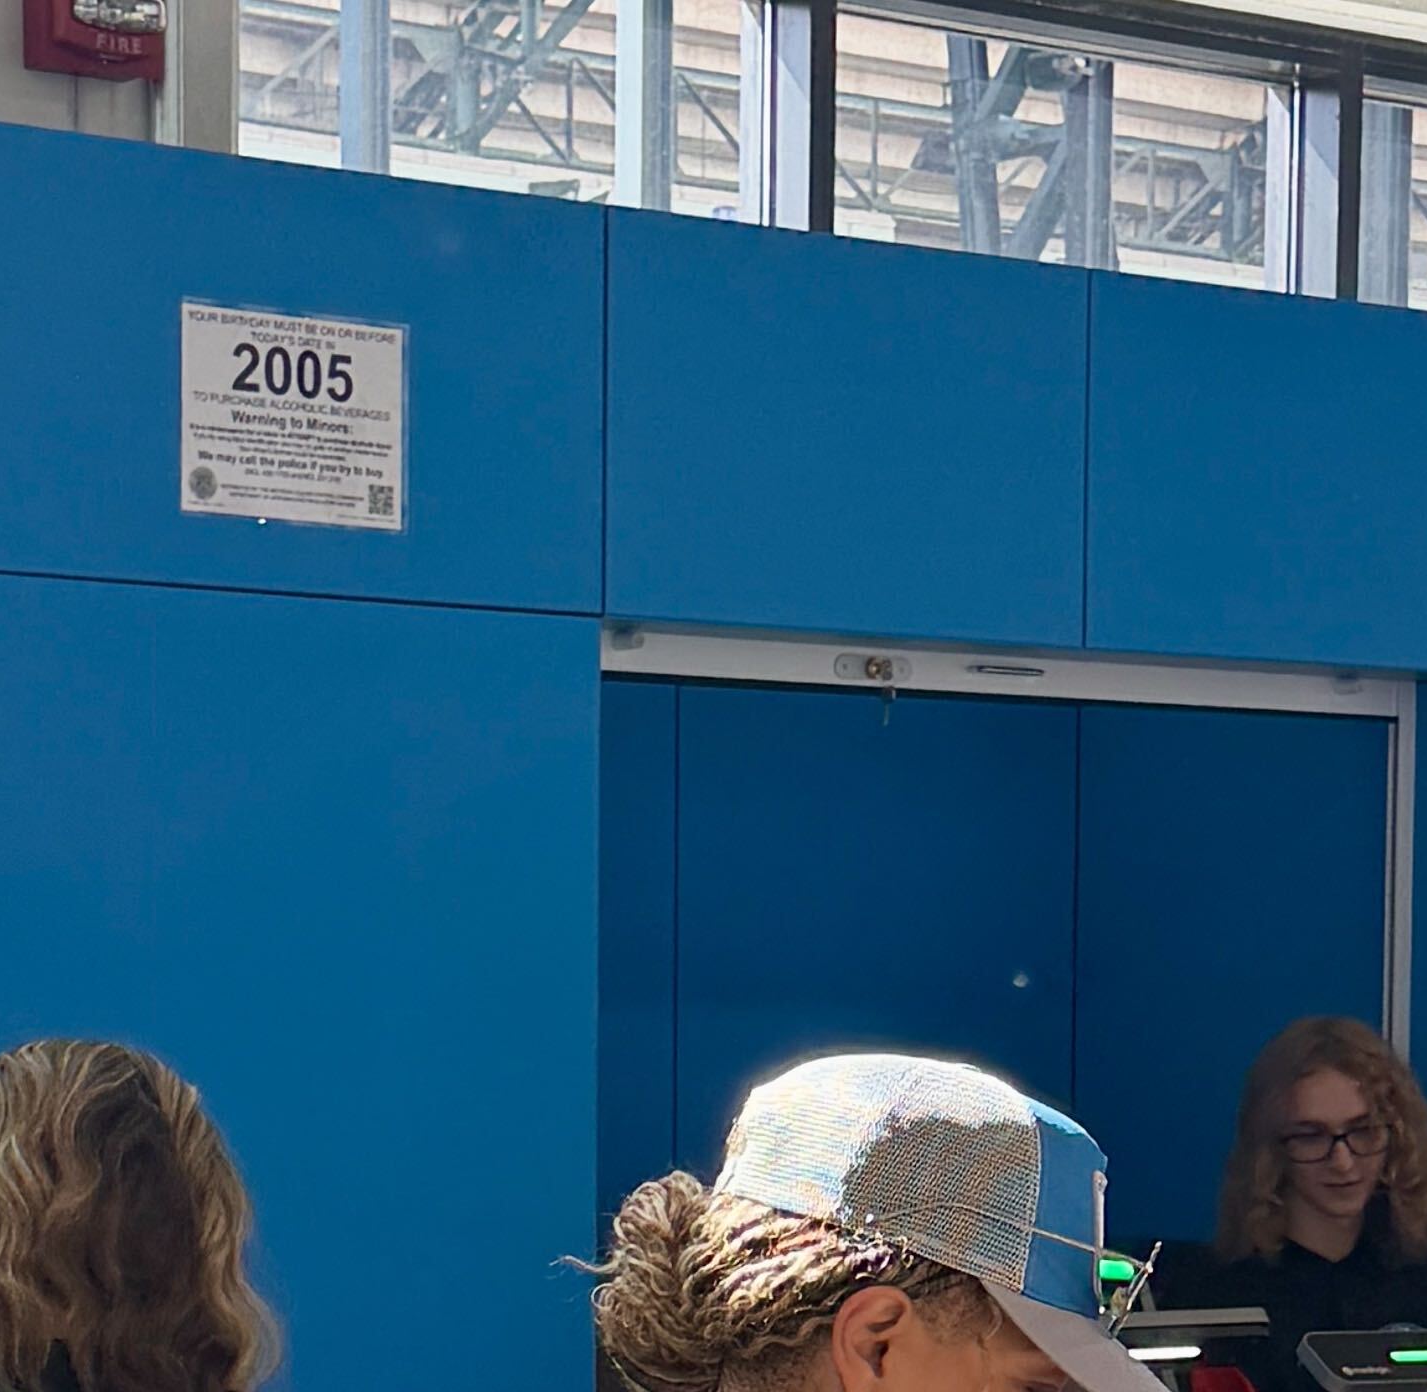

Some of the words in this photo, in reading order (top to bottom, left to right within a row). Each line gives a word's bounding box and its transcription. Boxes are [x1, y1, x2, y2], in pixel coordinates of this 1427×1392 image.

[95, 33, 143, 55] FIRE
[274, 320, 302, 333] MUST
[305, 323, 317, 335] BE
[232, 342, 354, 403] 2005
[231, 409, 286, 430] Warning
[290, 417, 303, 429] to
[270, 400, 329, 414] ALCOHOLIC
[330, 405, 391, 422] BEVERAGES
[217, 453, 236, 466] may
[239, 455, 257, 465] call
[259, 456, 275, 466] the
[278, 458, 307, 470] police
[319, 464, 337, 475] you
[366, 466, 383, 480] buy
